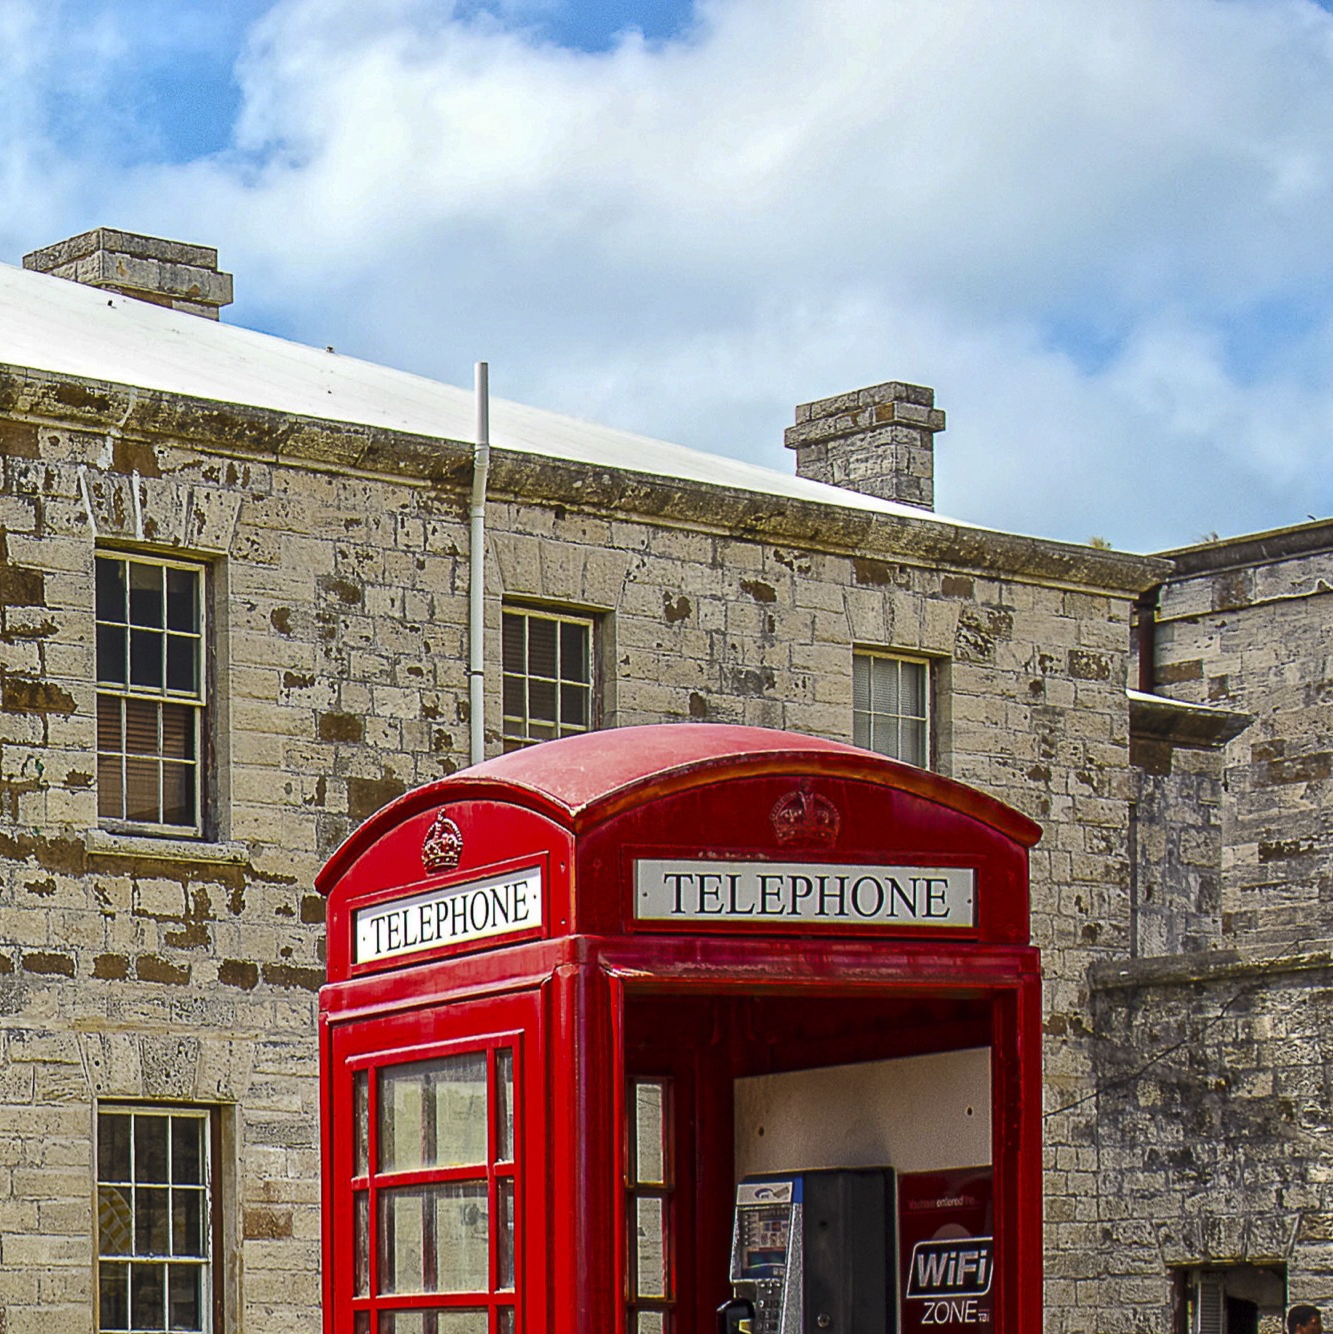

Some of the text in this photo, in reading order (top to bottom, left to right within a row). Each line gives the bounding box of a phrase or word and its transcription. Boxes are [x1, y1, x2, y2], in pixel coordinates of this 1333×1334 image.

[370, 880, 530, 954] TELEPHONE
[663, 873, 951, 919] TELEPHONE
[917, 1249, 988, 1287] WiFi
[921, 1300, 978, 1324] ZONE
